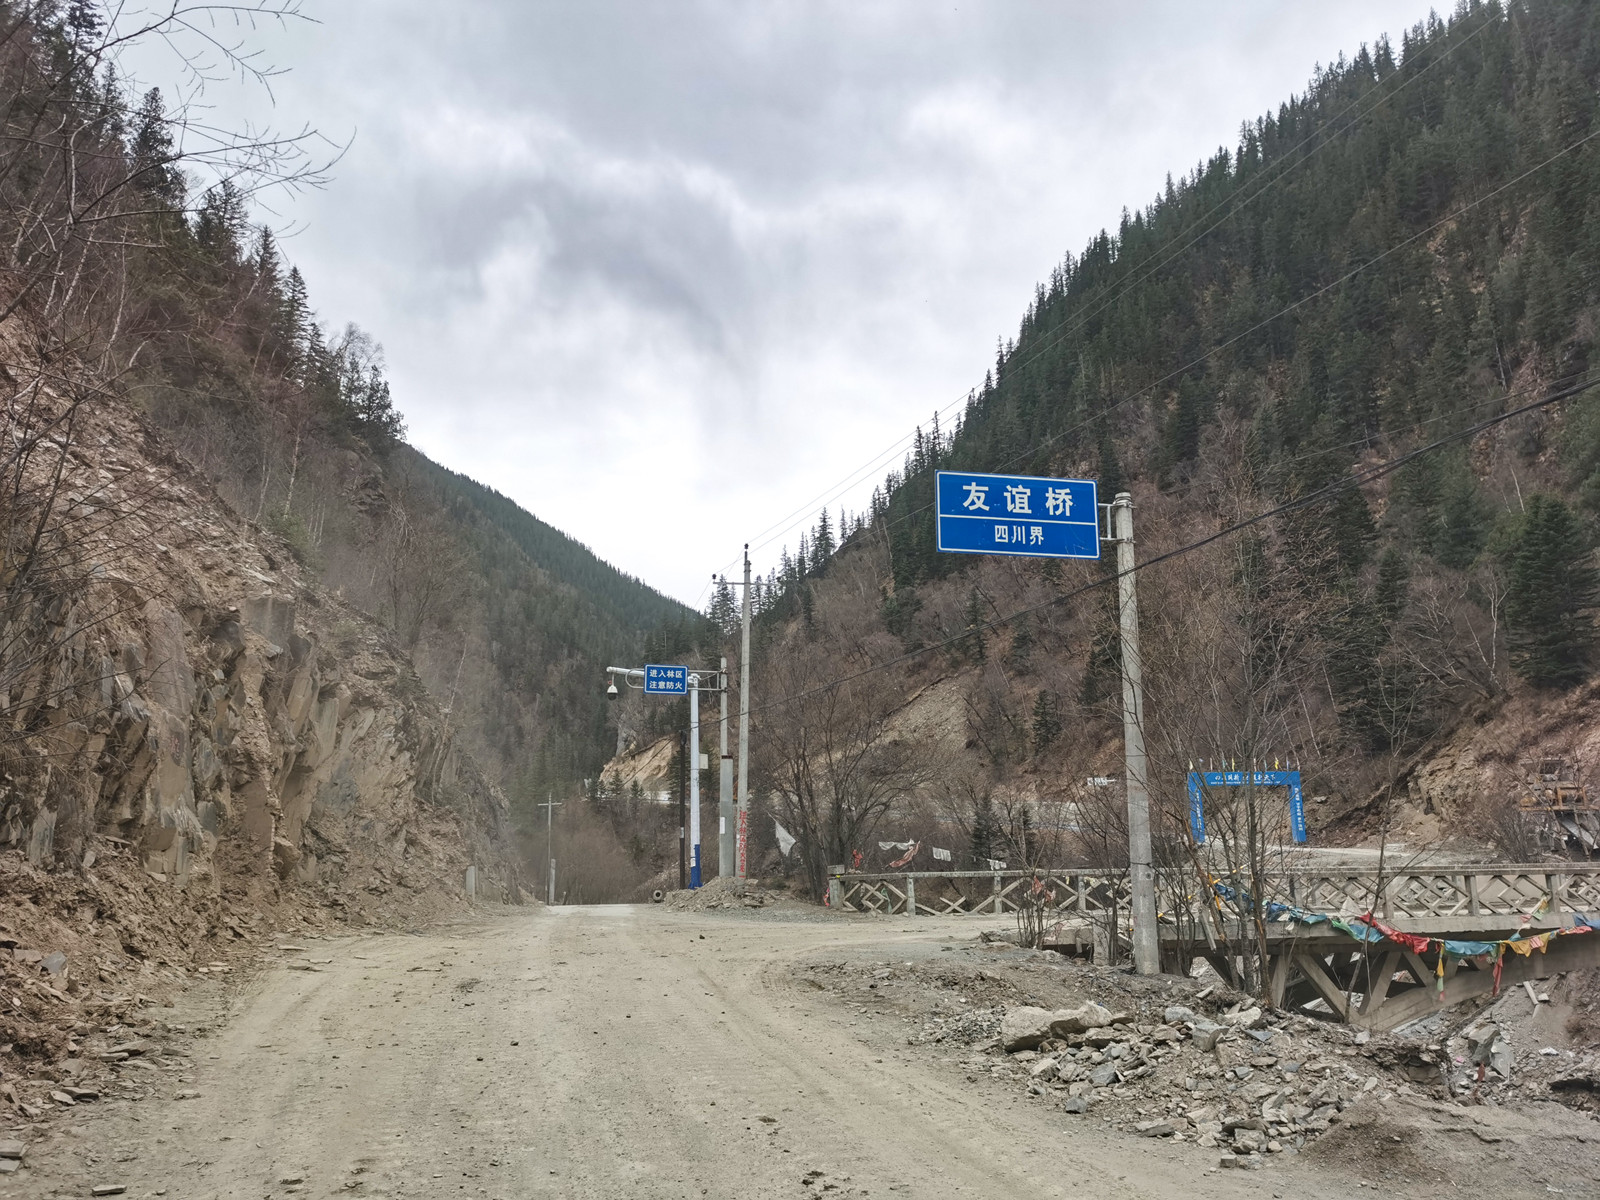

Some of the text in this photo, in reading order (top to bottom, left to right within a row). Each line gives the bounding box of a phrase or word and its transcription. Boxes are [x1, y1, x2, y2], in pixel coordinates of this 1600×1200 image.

[962, 482, 1074, 517] 友谊桥
[994, 525, 1045, 546] 四川界
[649, 669, 683, 679] 进入林区
[649, 681, 683, 690] 注意防火
